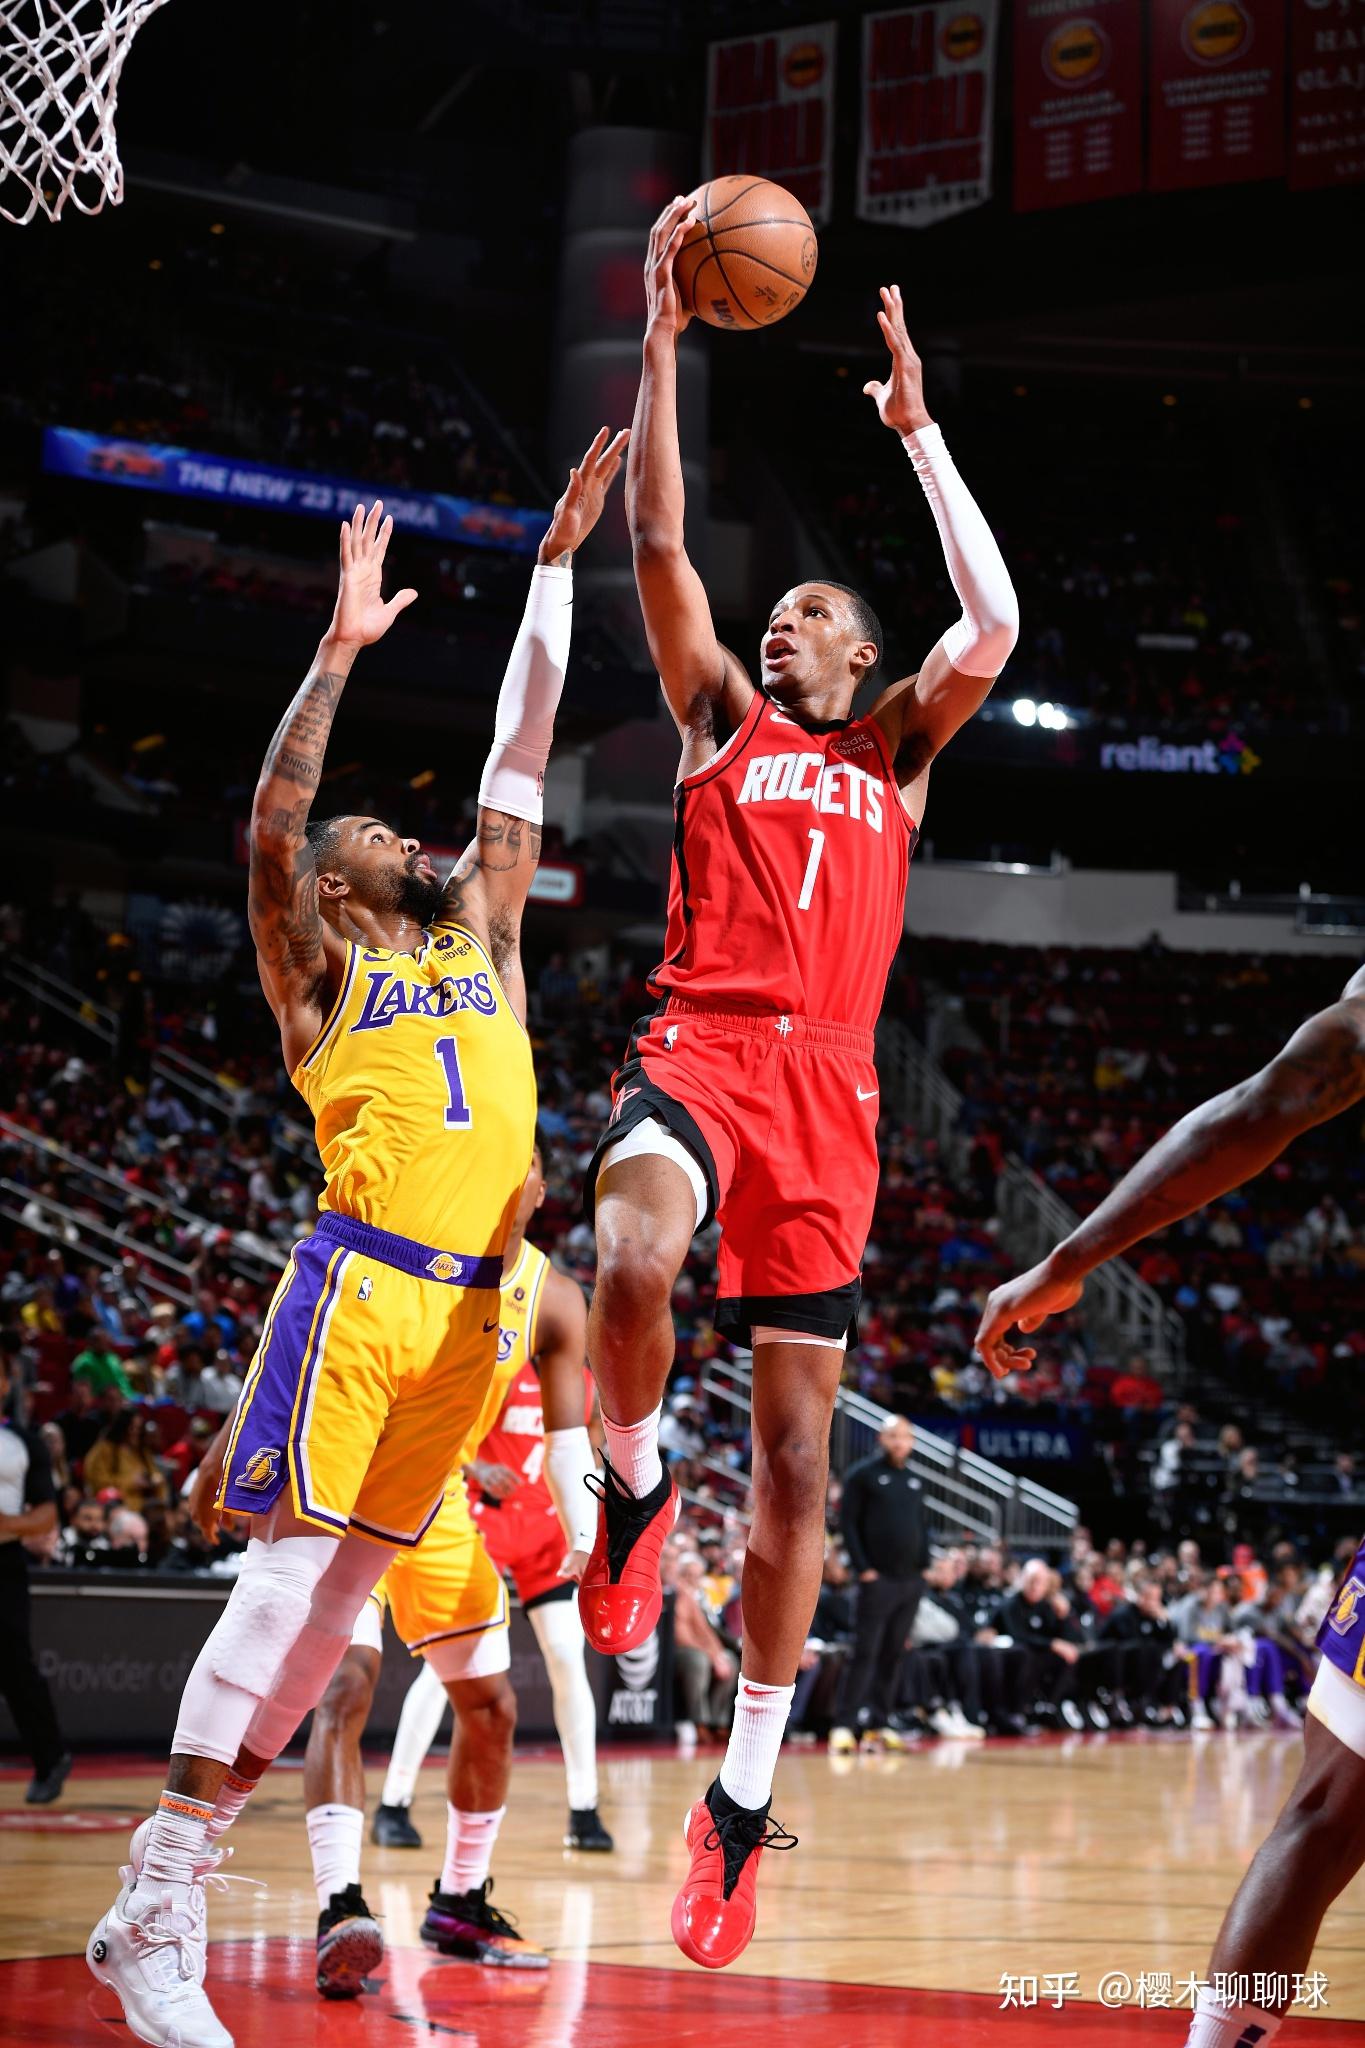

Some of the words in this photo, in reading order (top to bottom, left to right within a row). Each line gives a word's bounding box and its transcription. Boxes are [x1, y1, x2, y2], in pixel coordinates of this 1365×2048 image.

[178, 459, 229, 493] THE
[229, 469, 295, 504] NEW
[1100, 736, 1221, 774] reliant
[797, 827, 826, 911] 1
[348, 970, 498, 1036] LAKERS
[432, 1034, 474, 1131] 1
[978, 1428, 1073, 1461] ULTRA
[39, 1649, 155, 1693] Provider
